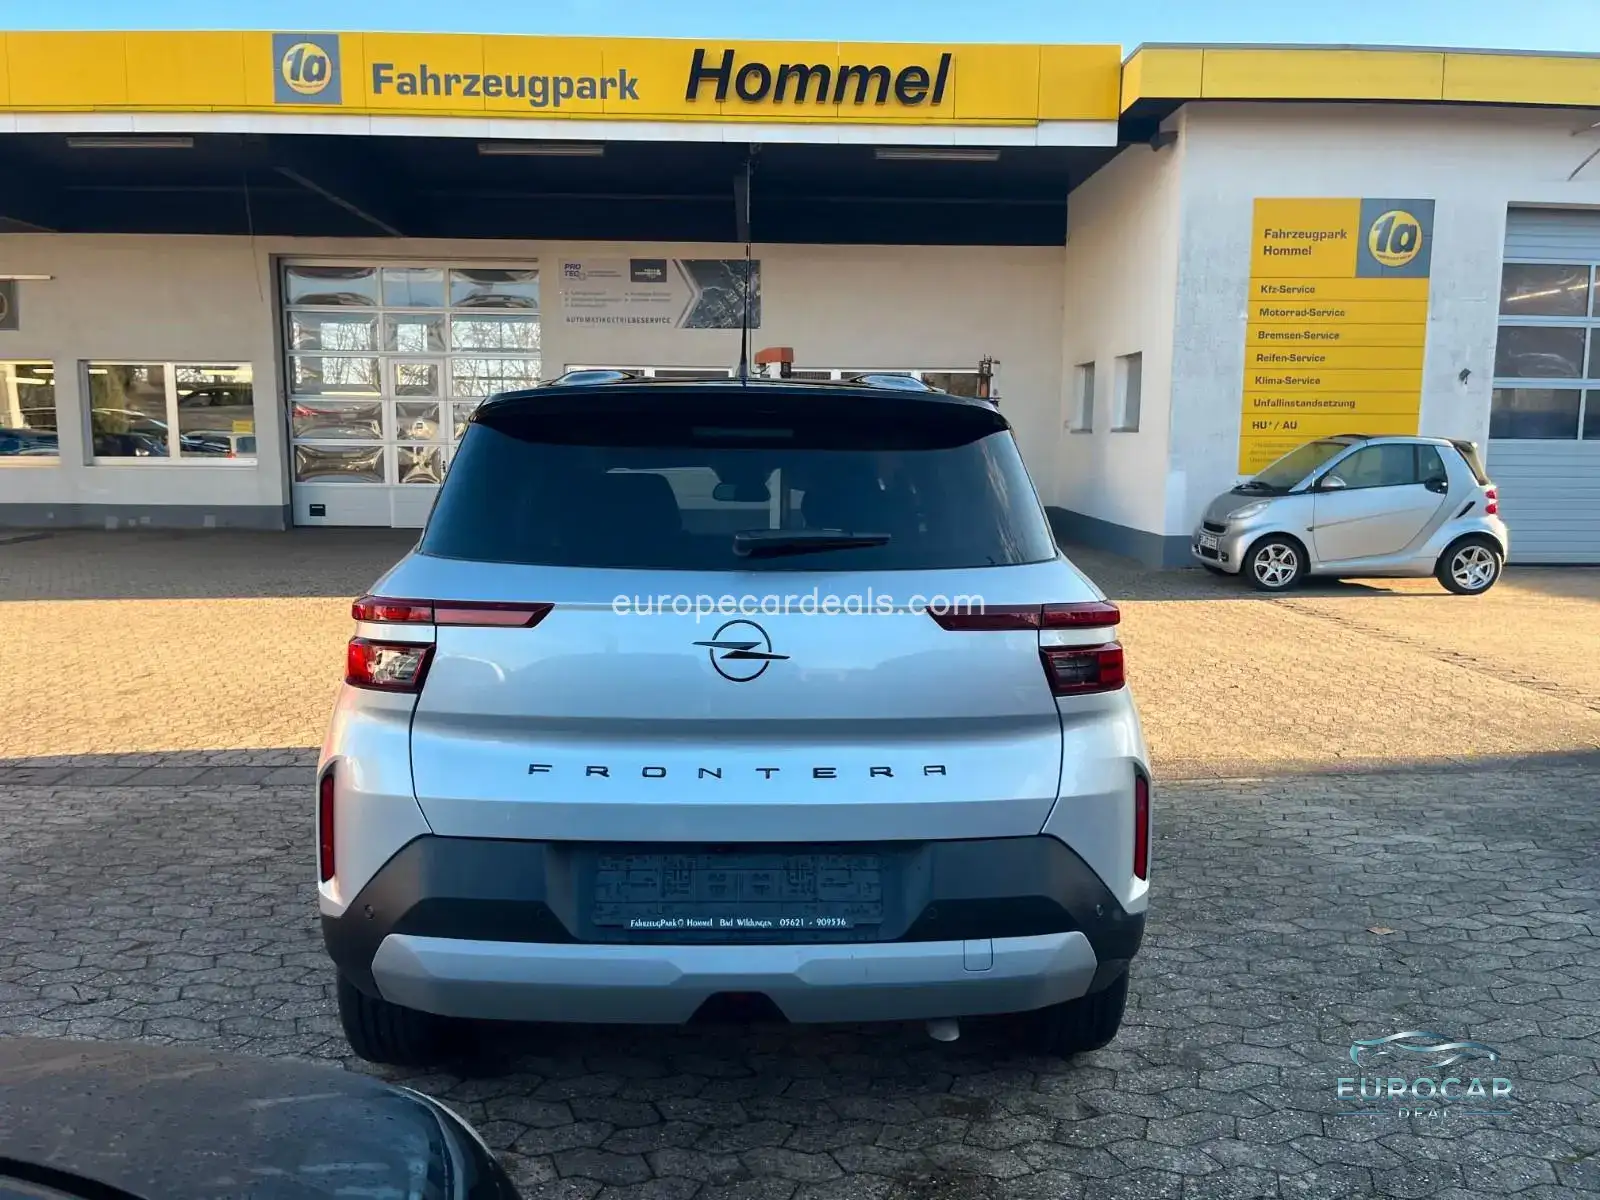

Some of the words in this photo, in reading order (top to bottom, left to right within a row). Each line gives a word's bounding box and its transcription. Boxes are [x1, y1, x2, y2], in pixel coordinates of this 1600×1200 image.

[372, 63, 640, 107] Fahrzeugpark
[685, 48, 952, 106] Hommel
[1264, 228, 1347, 242] Fahrzeugpark
[1263, 245, 1312, 256] Hommel
[1260, 284, 1315, 294] Kfz-Service
[1259, 308, 1345, 317] Motorrad-Service
[1257, 330, 1340, 340] Bremsen-Service
[1256, 353, 1326, 363] Reifen-Service
[1254, 375, 1321, 385] Klima-Service
[1253, 398, 1356, 409] Unfallinstandsetzung
[1282, 420, 1298, 430] AU
[528, 763, 947, 779] FRONTERA
[719, 918, 734, 927] Bad
[737, 918, 773, 928] Wildungen
[779, 918, 804, 927] 05621
